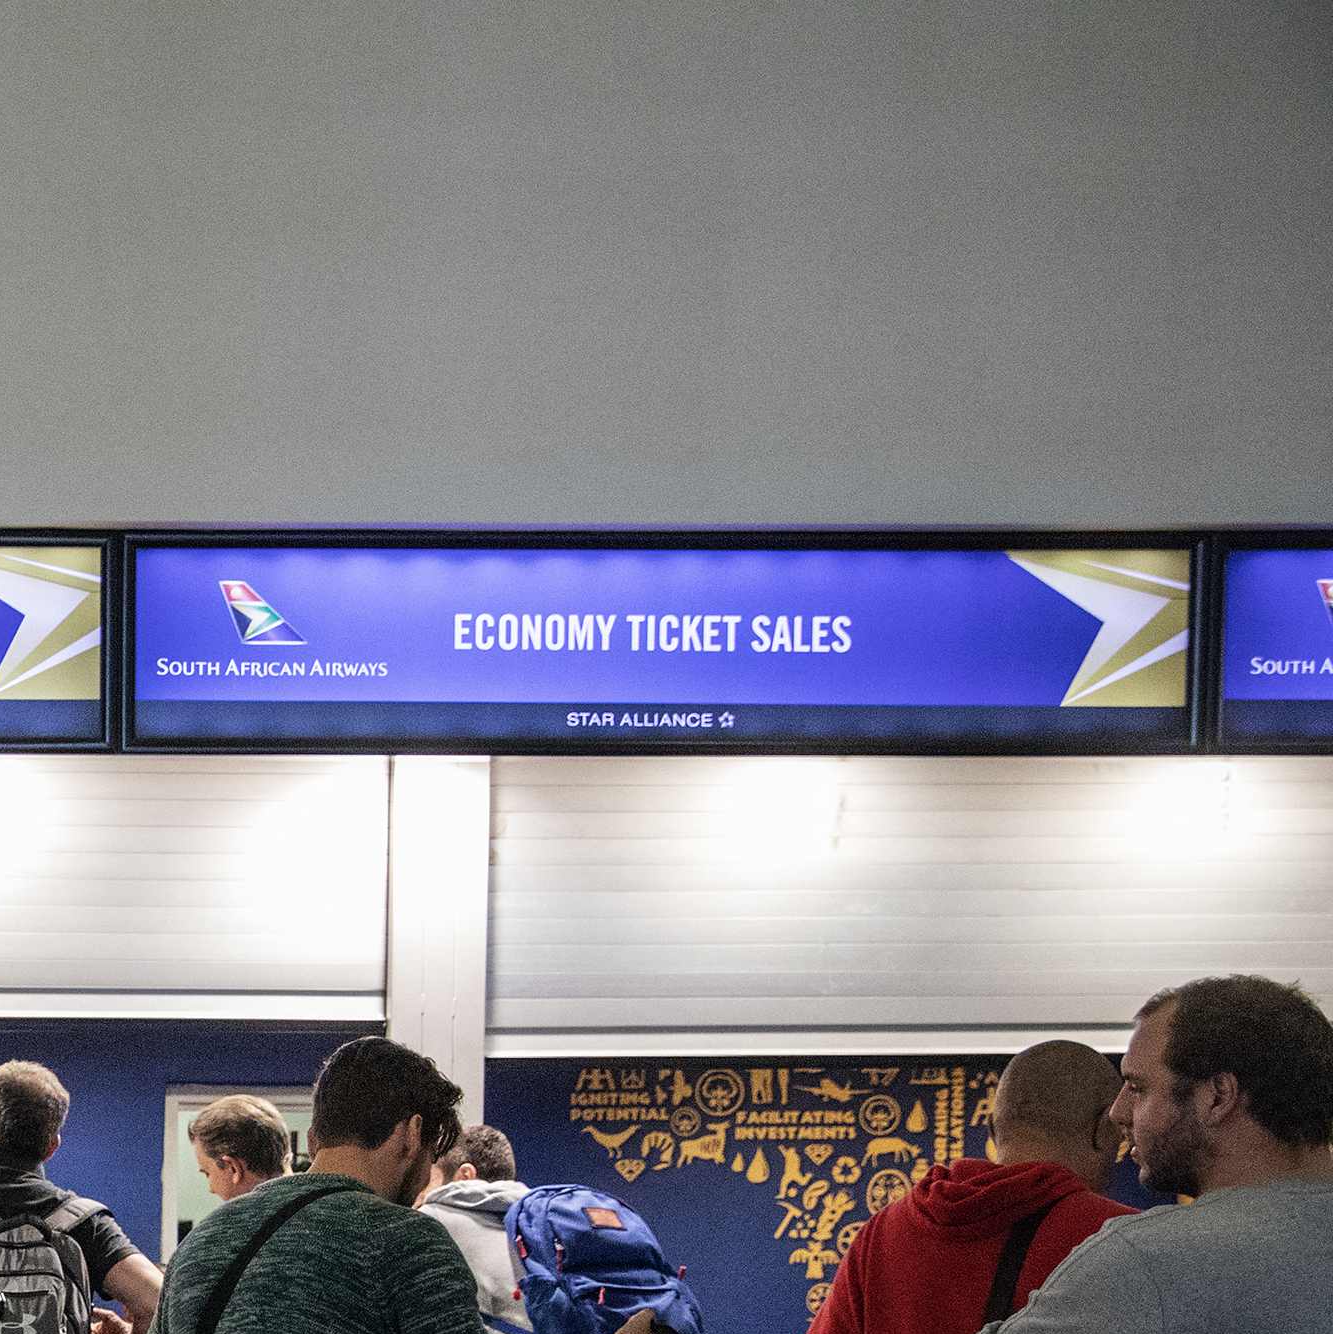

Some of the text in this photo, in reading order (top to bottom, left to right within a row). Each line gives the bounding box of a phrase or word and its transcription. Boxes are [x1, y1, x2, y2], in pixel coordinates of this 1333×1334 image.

[454, 613, 851, 653] ECONOMY TICKET SALES
[157, 658, 388, 678] SOUTH AFRICAN AIRWAYS
[1249, 657, 1316, 675] SOUTH
[566, 711, 713, 728] STAR ALLIANCE
[569, 1107, 670, 1121] POTENTIAL
[734, 1110, 854, 1124] FACILITATING
[734, 1126, 856, 1140] INVESTMENTS
